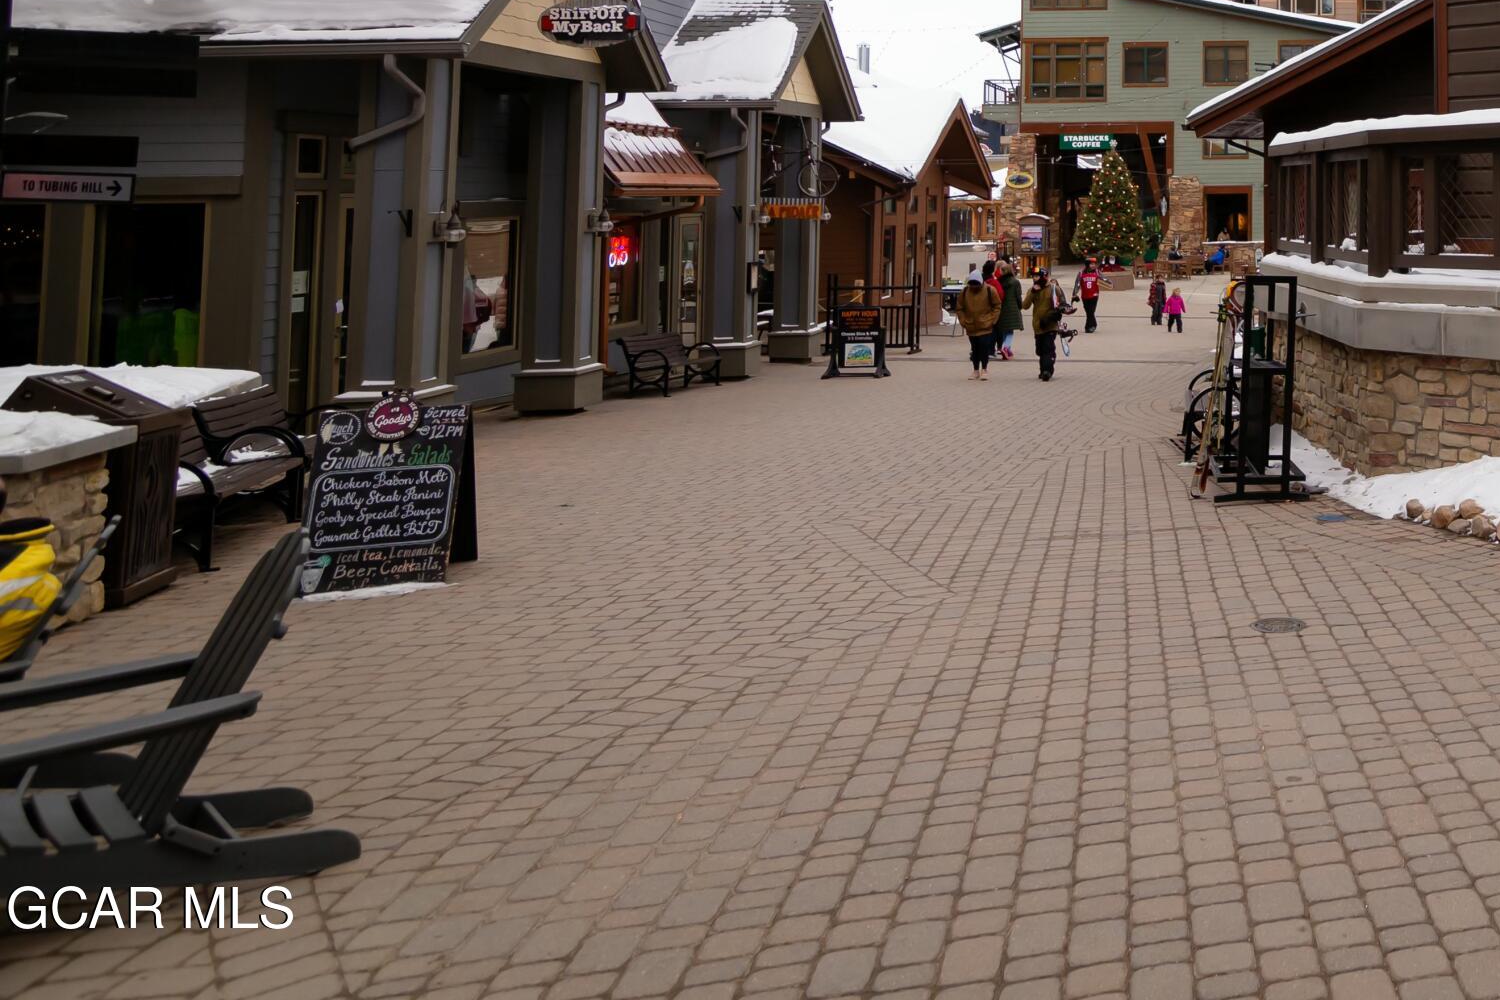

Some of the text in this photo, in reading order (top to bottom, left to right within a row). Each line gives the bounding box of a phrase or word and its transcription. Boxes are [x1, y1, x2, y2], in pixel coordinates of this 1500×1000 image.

[22, 179, 104, 194] TO TUBING HILL
[424, 405, 466, 419] Served
[321, 446, 395, 471] Sandwiches
[407, 443, 453, 465] Salads
[321, 469, 448, 492] Chicken Bacon Melt
[320, 486, 444, 510] Philly Steak Panini
[356, 505, 401, 526] Special
[401, 503, 445, 519] Burger
[314, 520, 443, 547] Gourmet Grilled BLT
[337, 552, 360, 565] Iced
